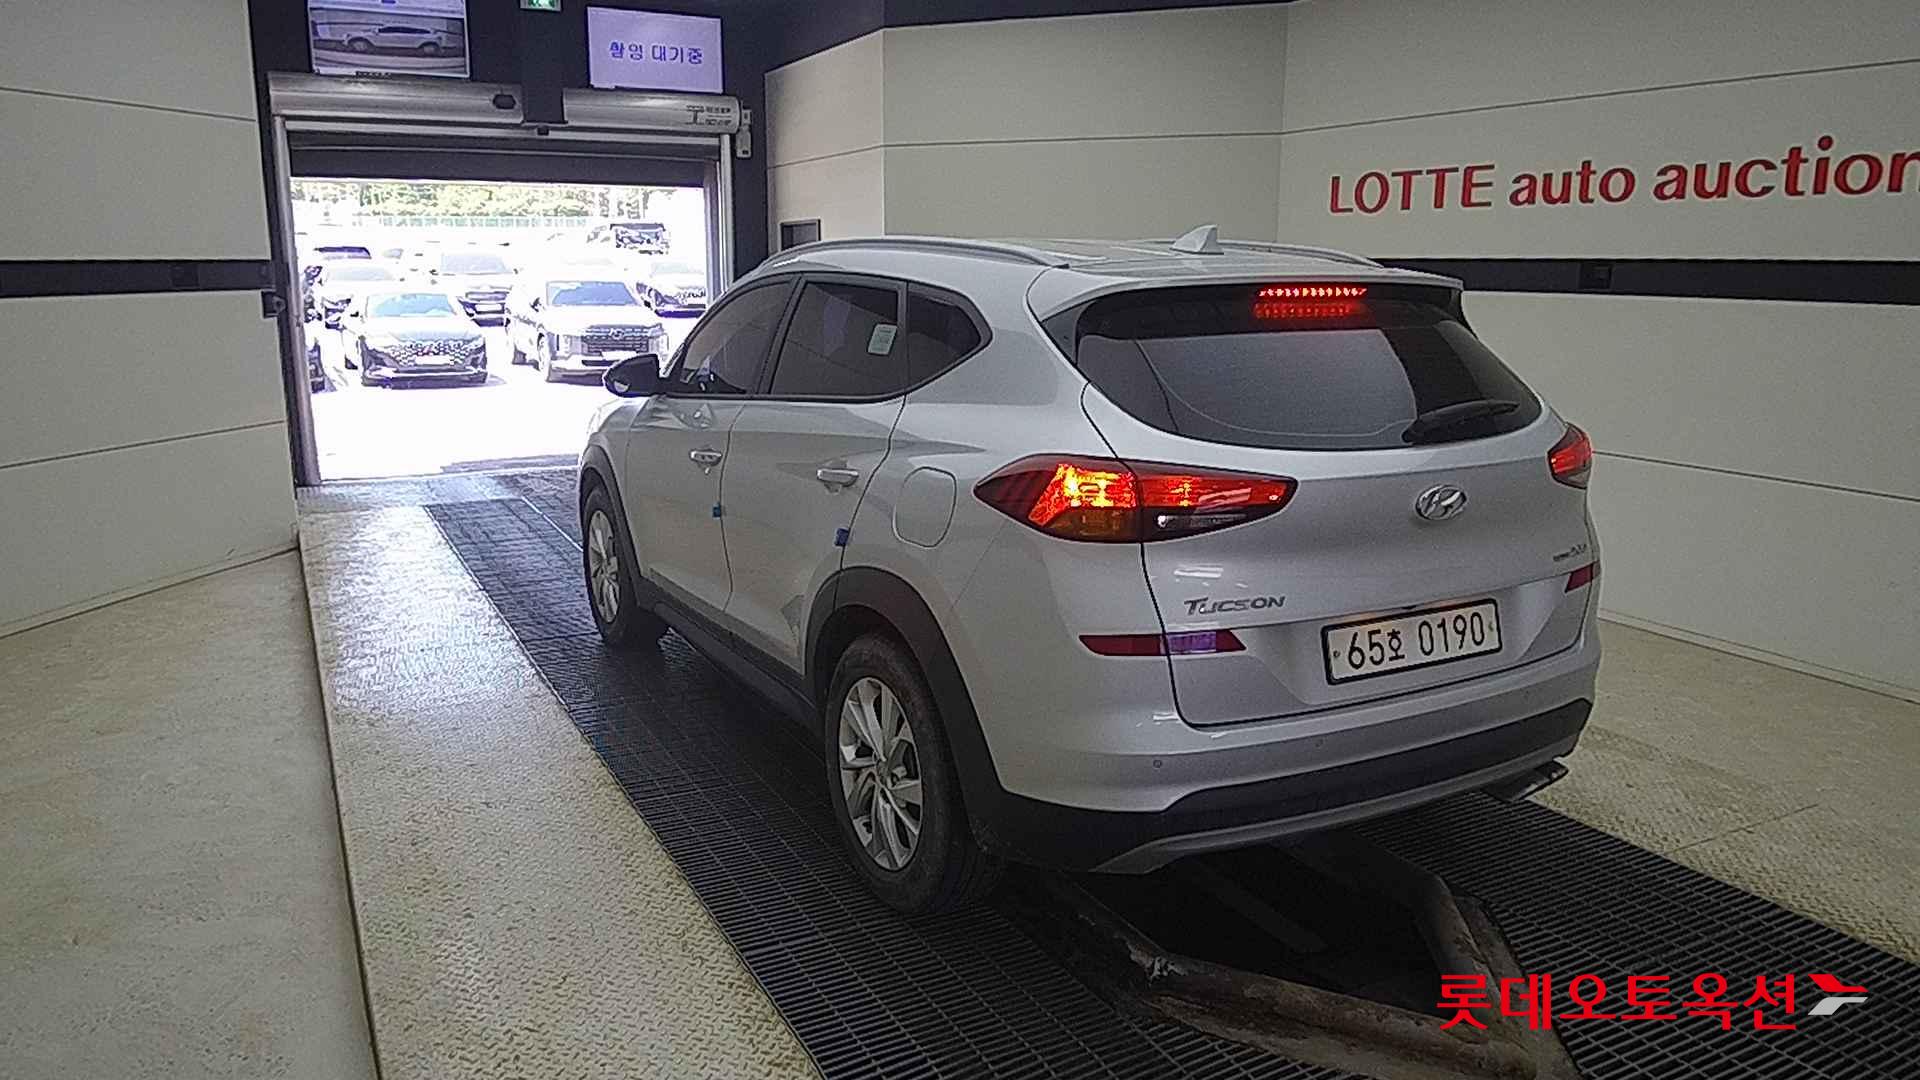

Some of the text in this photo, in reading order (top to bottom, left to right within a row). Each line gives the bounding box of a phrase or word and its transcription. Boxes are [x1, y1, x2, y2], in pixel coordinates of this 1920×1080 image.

[651, 44, 703, 65] 대기중
[1330, 164, 1495, 213] LOTTE
[1509, 160, 1635, 205] auto
[1348, 611, 1485, 669] 65호 0190
